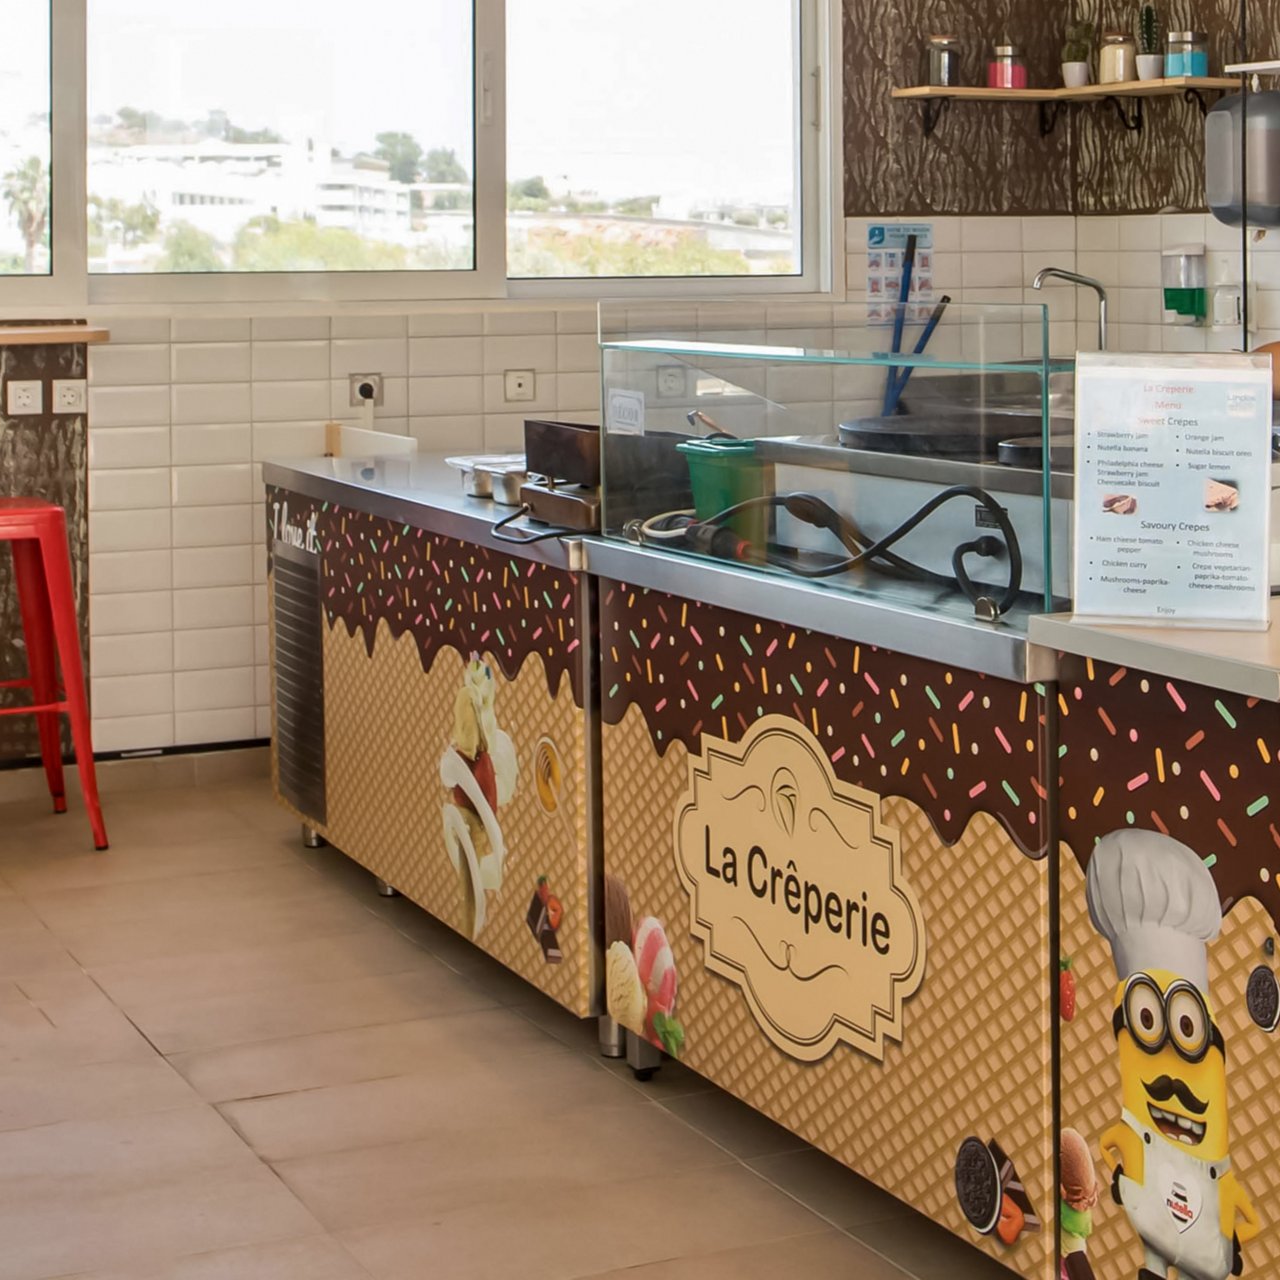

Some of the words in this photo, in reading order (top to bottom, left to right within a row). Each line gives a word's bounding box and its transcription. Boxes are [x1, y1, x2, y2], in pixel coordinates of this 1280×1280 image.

[1155, 401, 1183, 410] Menu
[1140, 521, 1177, 532] Savoury
[1178, 522, 1210, 532] Crepes
[705, 824, 738, 888] La
[746, 845, 891, 956] Crêperie
